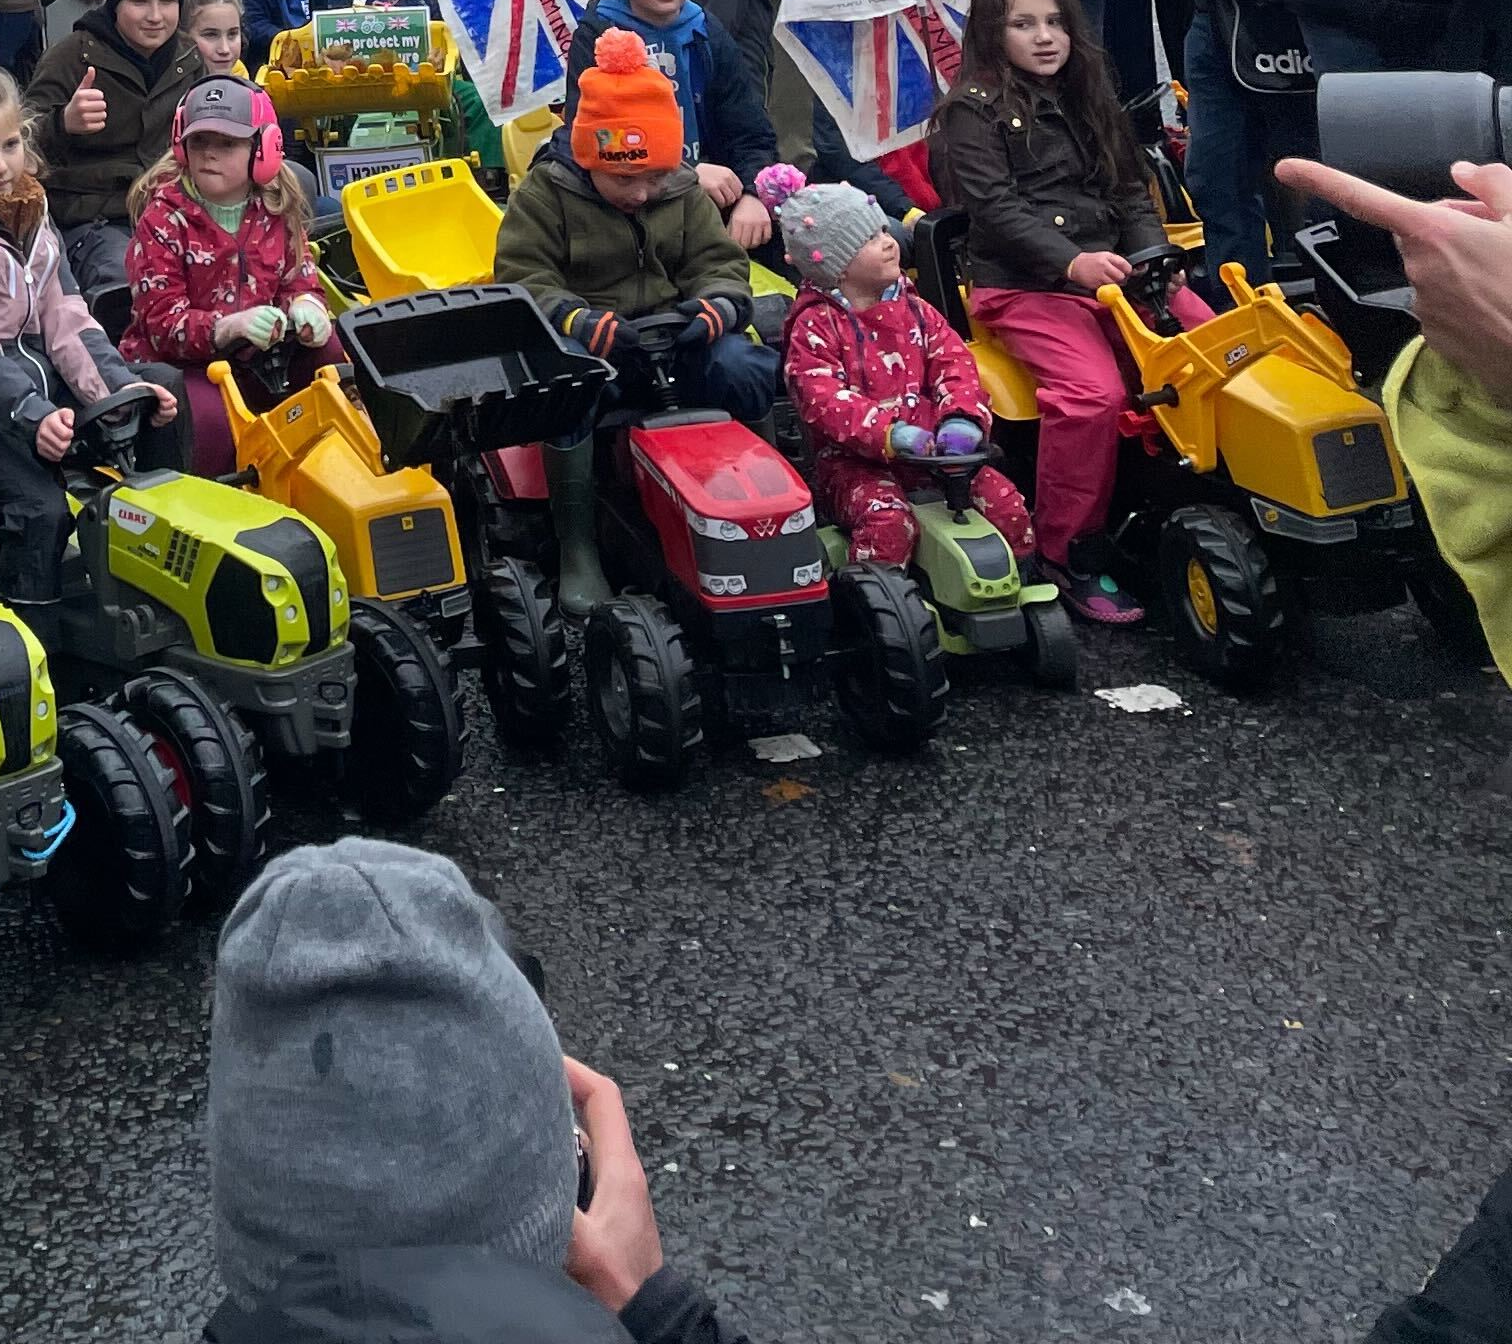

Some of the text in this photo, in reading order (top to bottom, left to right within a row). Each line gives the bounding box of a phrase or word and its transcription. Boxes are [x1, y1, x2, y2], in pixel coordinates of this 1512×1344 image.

[352, 34, 400, 51] protect
[401, 35, 430, 49] my
[598, 149, 649, 161] PUMPKINS
[118, 508, 148, 526] CLAAS
